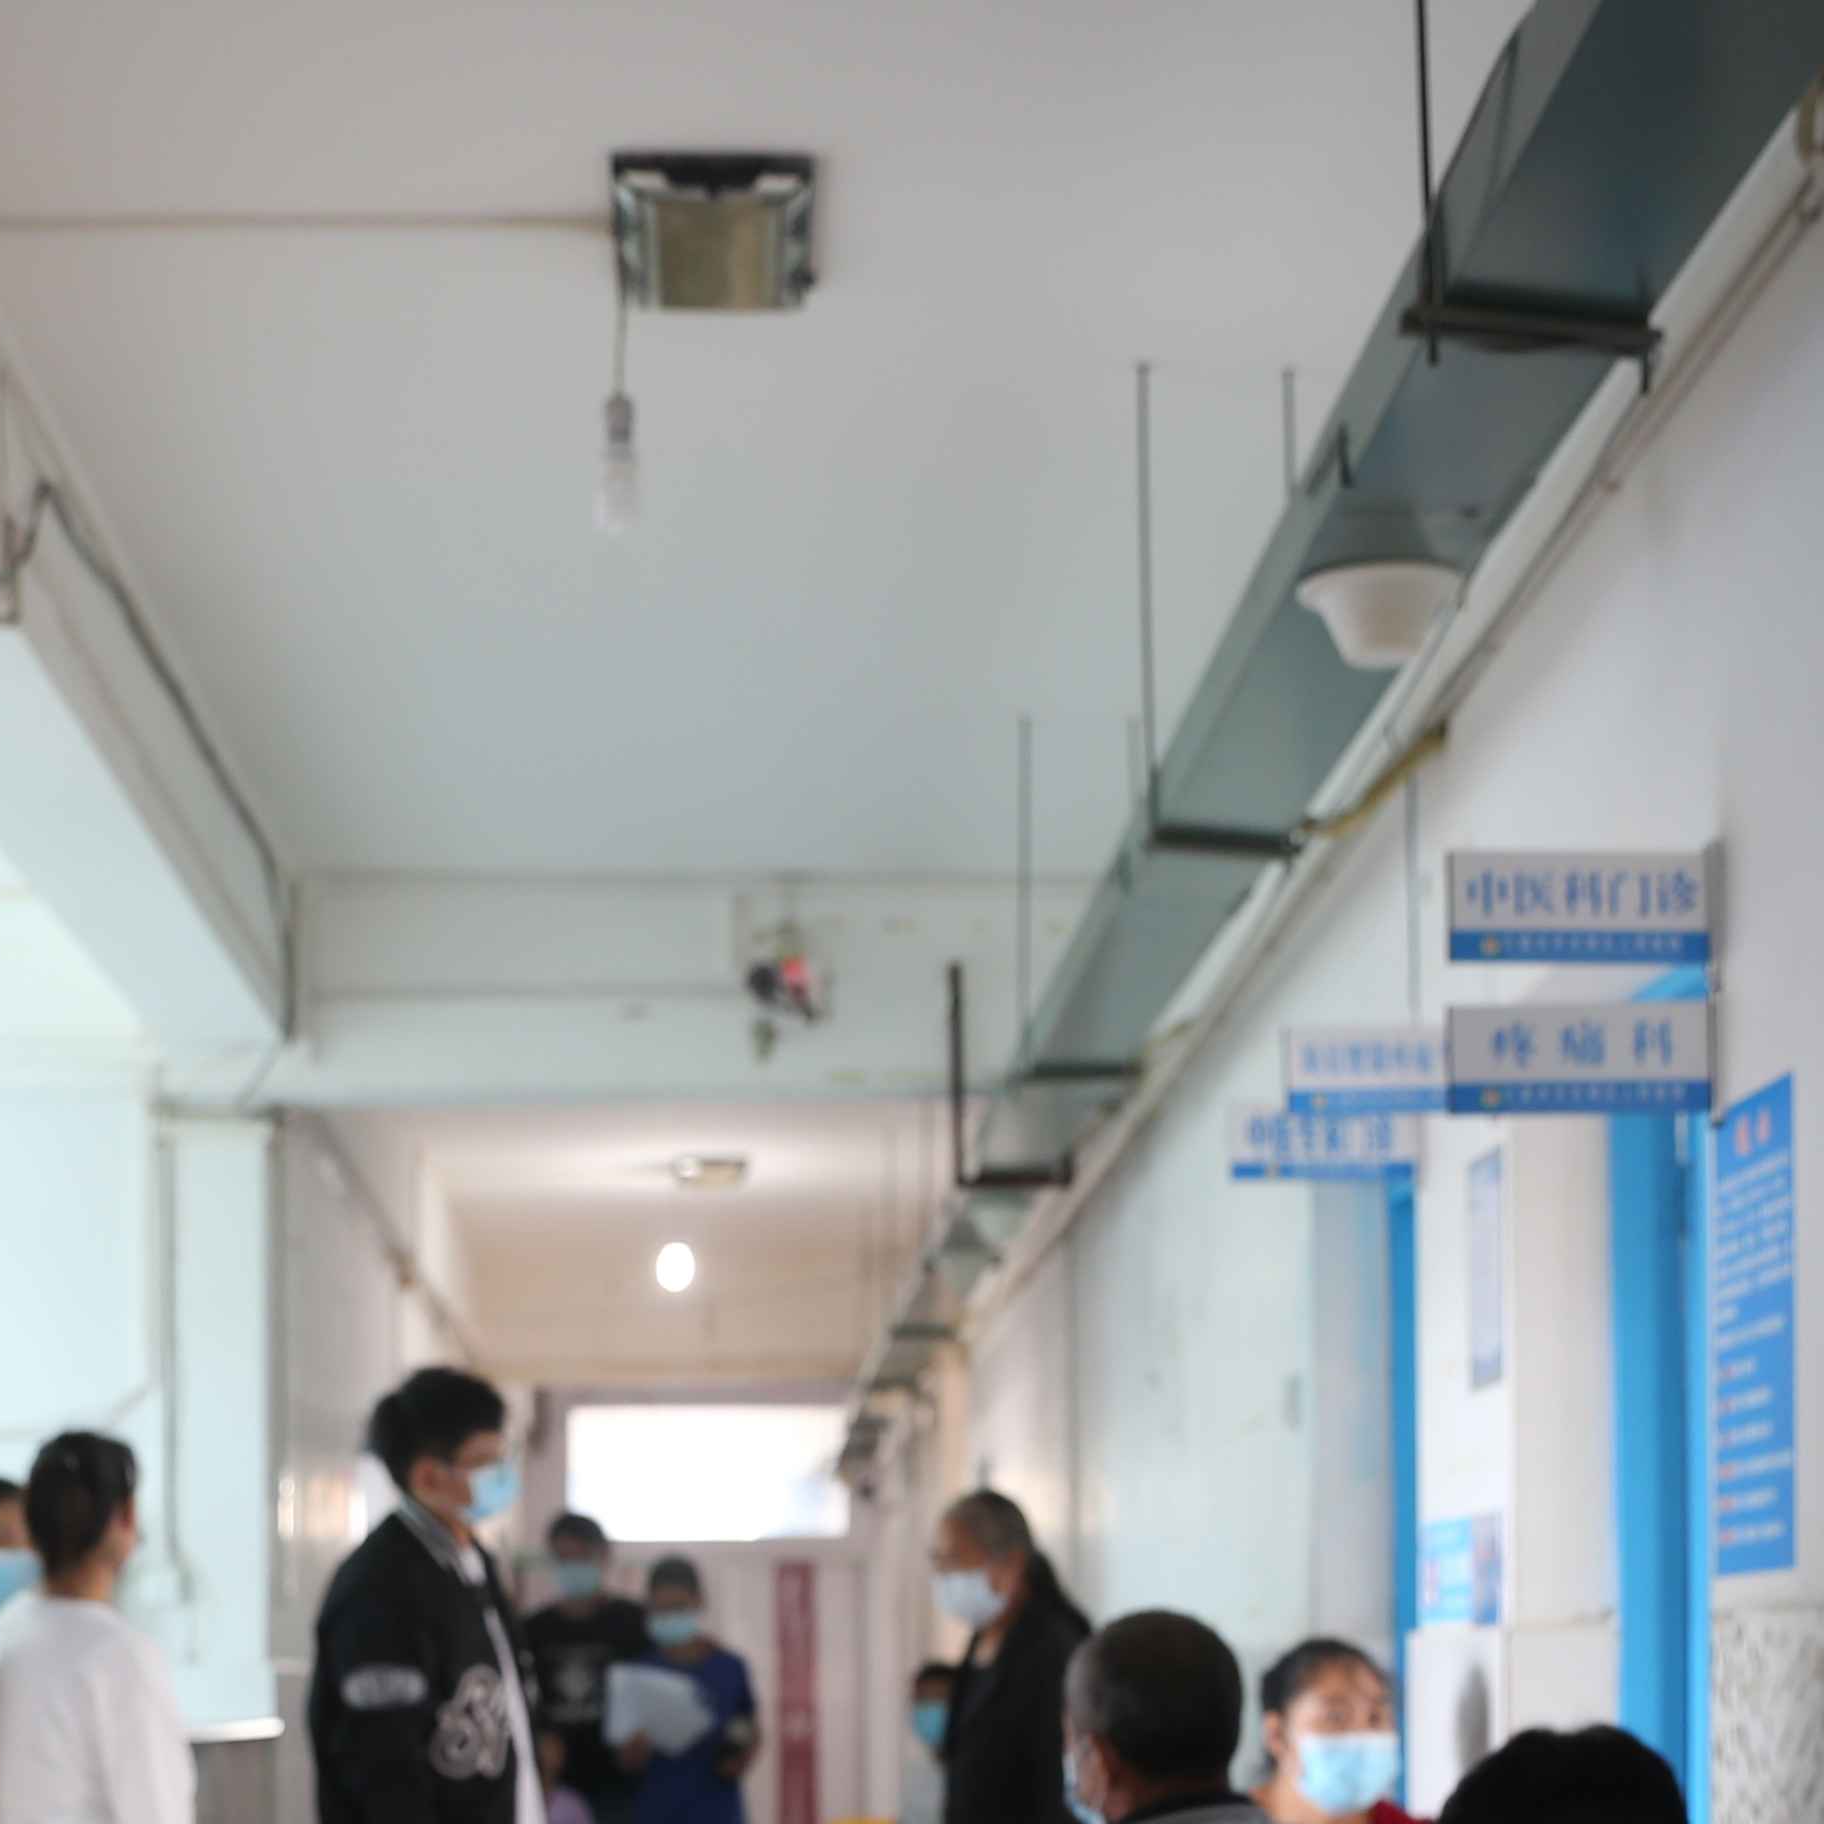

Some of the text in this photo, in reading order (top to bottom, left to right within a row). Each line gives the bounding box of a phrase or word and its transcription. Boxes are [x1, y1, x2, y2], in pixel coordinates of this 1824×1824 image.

[1466, 867, 1699, 917] 中医科门诊
